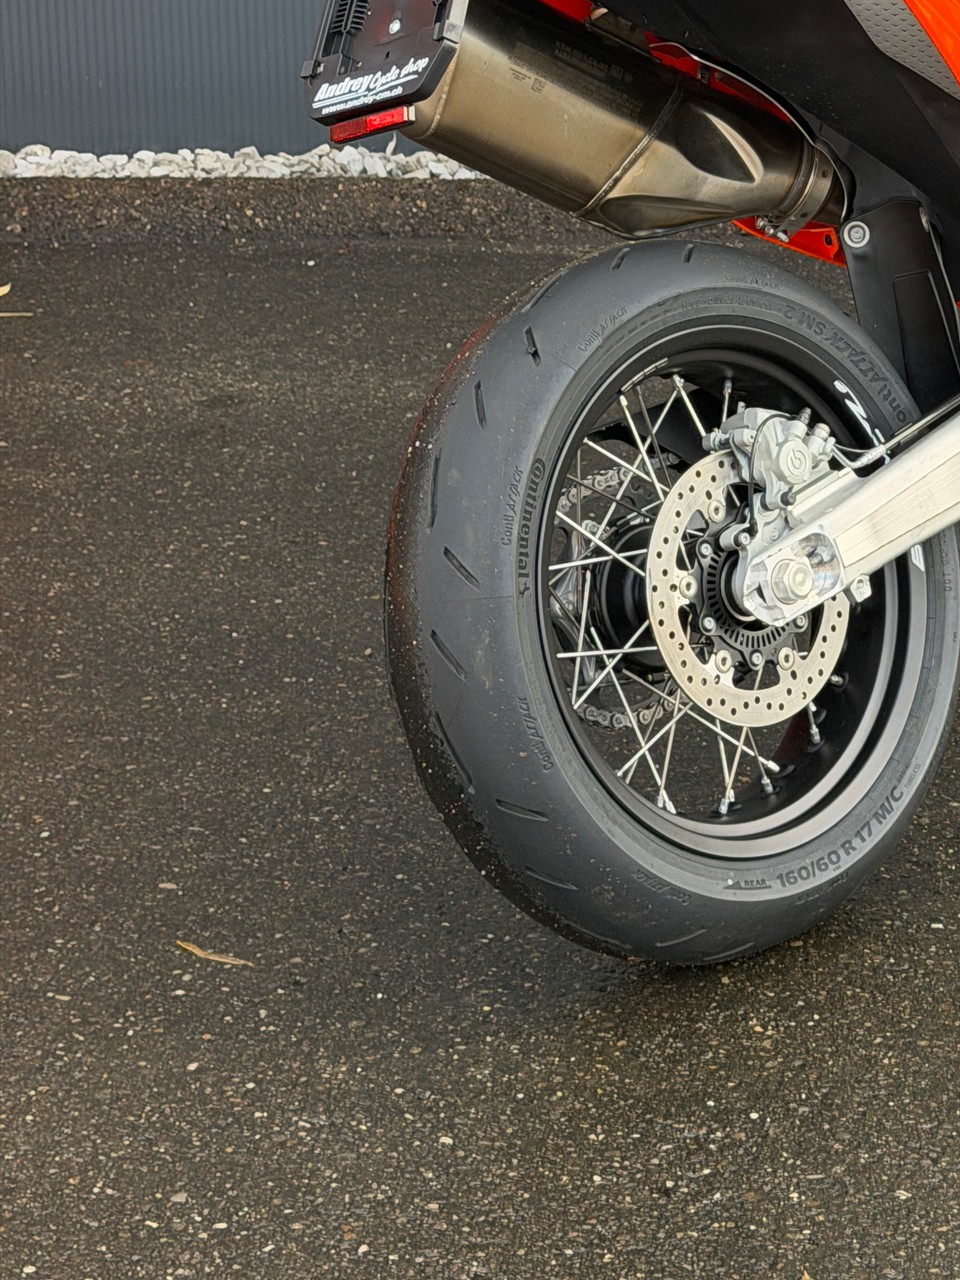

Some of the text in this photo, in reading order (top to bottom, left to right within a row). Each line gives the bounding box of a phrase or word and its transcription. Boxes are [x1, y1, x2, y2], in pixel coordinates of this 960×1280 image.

[313, 74, 374, 102] Andrey
[370, 65, 400, 90] Cycle
[517, 457, 546, 579] Continental
[776, 786, 904, 888] 160/60 R 17 M/C
[743, 878, 768, 887] REAR
